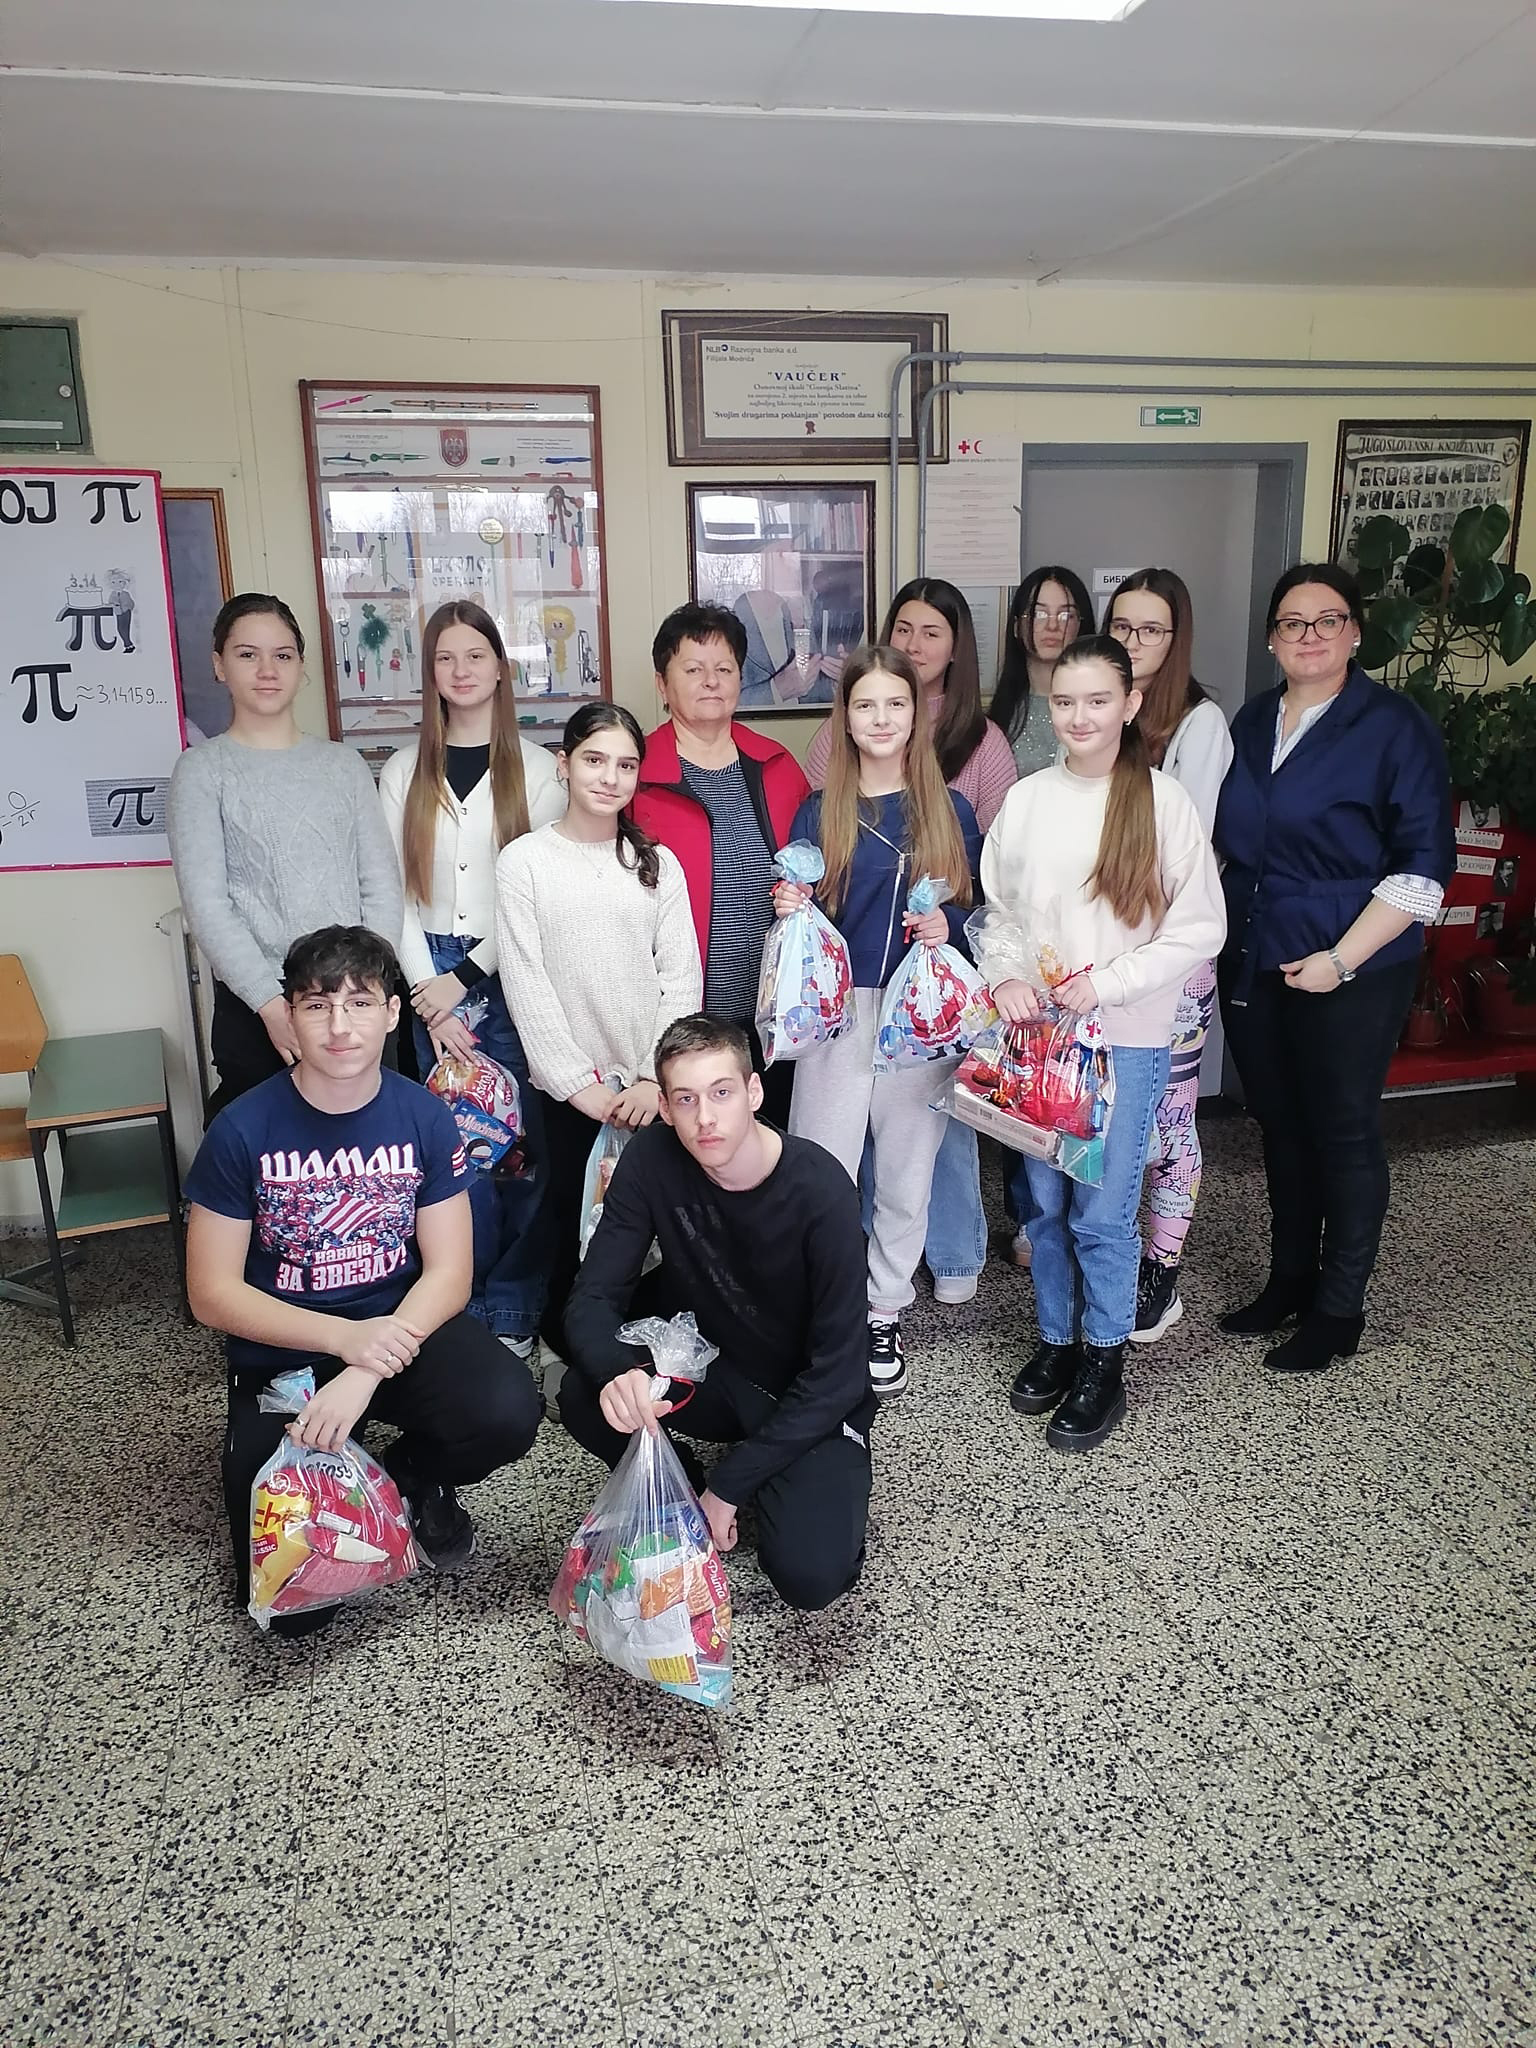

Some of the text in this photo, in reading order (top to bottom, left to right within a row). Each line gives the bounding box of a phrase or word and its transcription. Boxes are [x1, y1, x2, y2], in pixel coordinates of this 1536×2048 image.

[1158, 1204, 1176, 1213] ONLY
[314, 1240, 372, 1265] навија
[276, 1262, 305, 1292] ЗА
[254, 1544, 276, 1555] LASSIC
[708, 1559, 726, 1600] Prima
